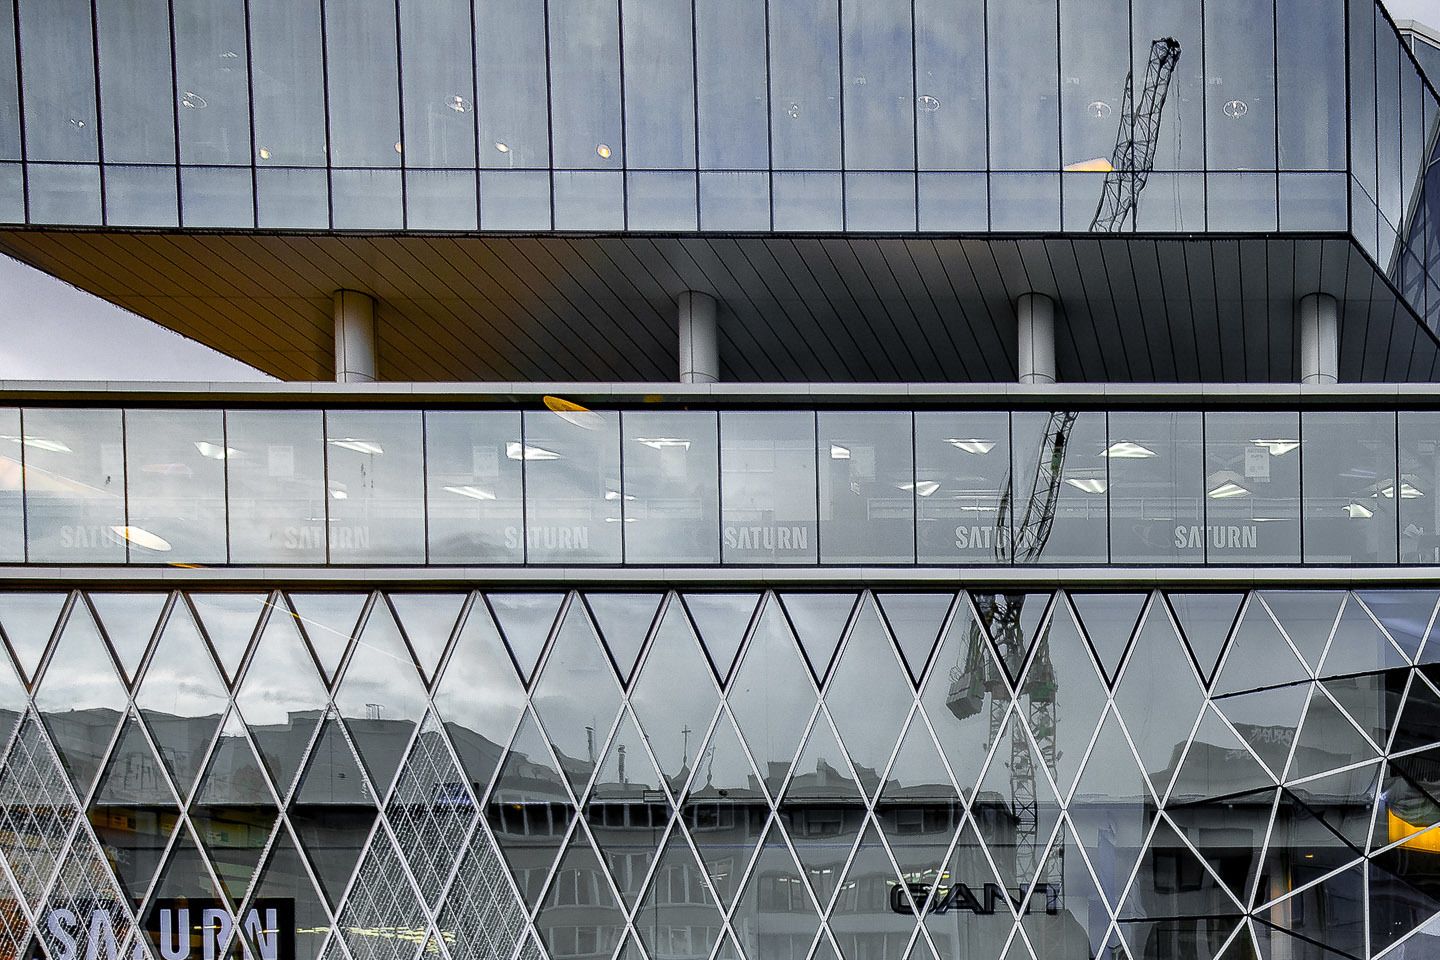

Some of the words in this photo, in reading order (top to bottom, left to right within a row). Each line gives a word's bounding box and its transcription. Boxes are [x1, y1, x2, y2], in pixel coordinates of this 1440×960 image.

[504, 526, 589, 549] SATURN
[724, 526, 808, 550] SATURN
[1174, 525, 1257, 548] SATURN
[890, 882, 1061, 915] GANT
